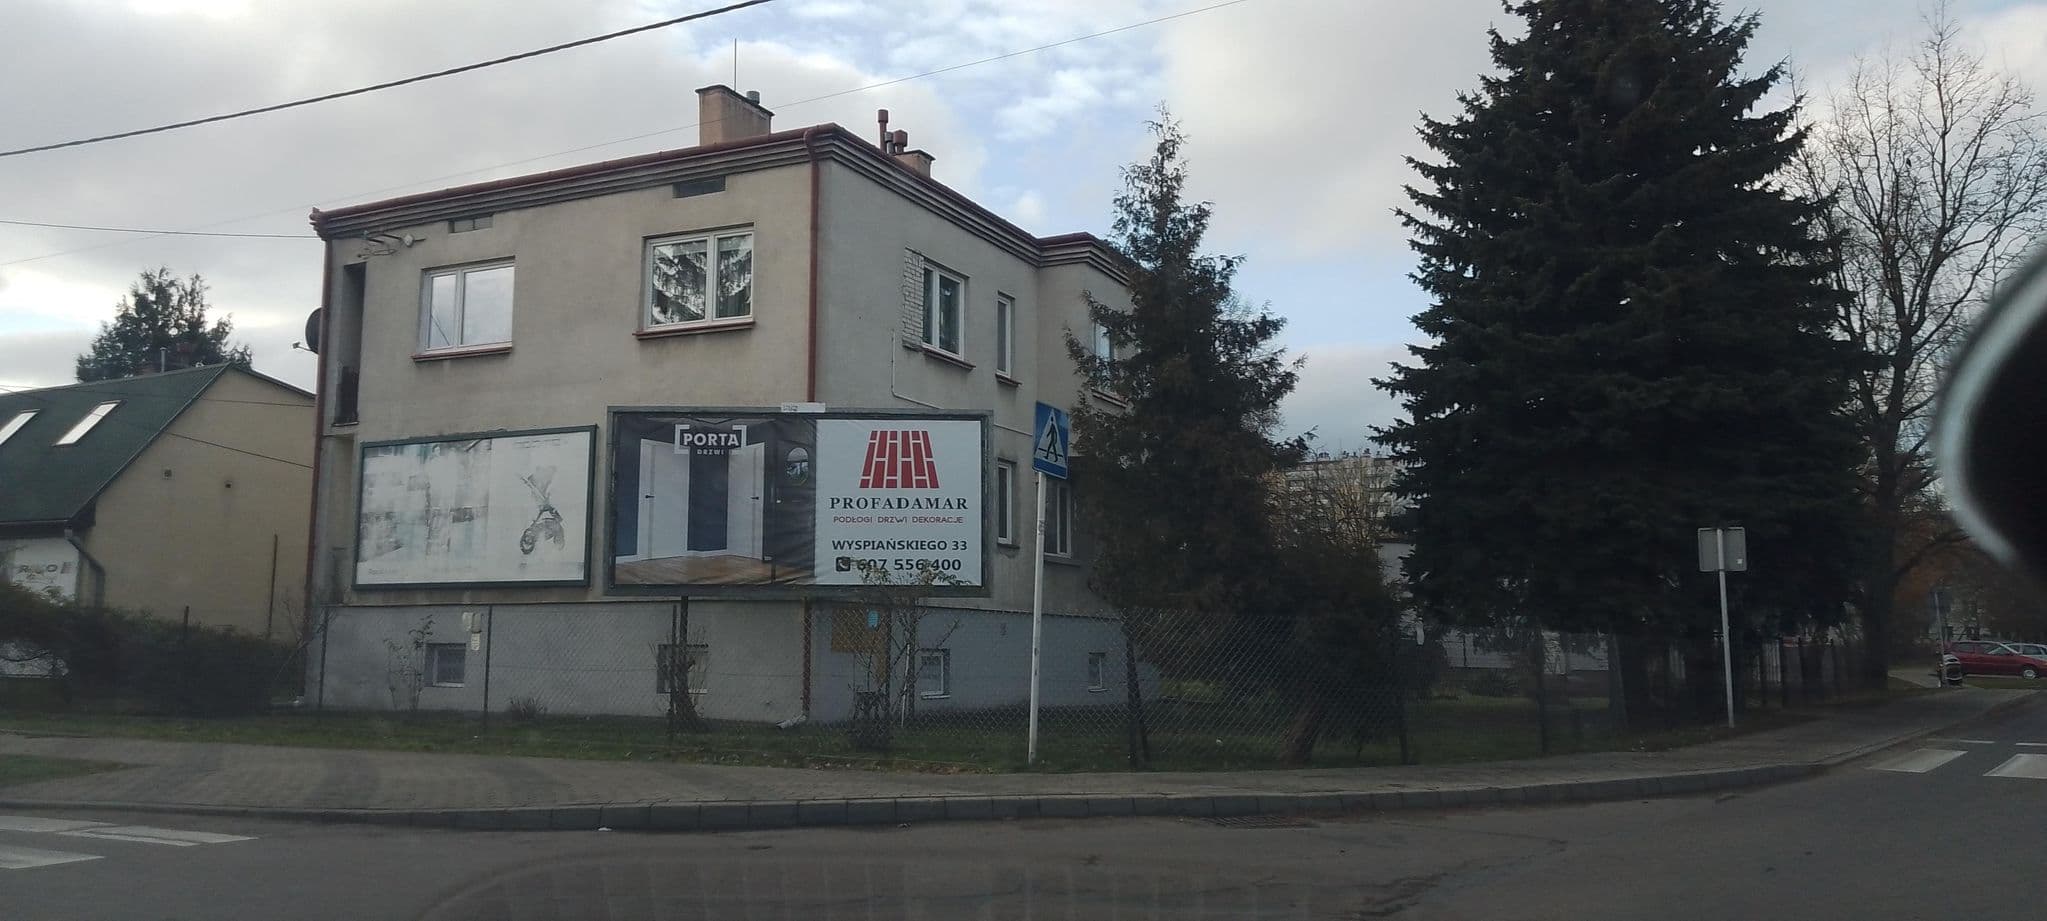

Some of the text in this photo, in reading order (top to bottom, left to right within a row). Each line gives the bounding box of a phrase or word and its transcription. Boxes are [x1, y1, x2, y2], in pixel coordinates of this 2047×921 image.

[683, 433, 739, 446] PORTA
[830, 497, 968, 510] PROFADAMAR
[833, 516, 964, 524] PODŁOGI DRZWI DEKORACJE
[832, 538, 968, 551] WYSPIAŃSKIEGO 33
[894, 559, 924, 571] 556
[930, 559, 961, 571] 400
